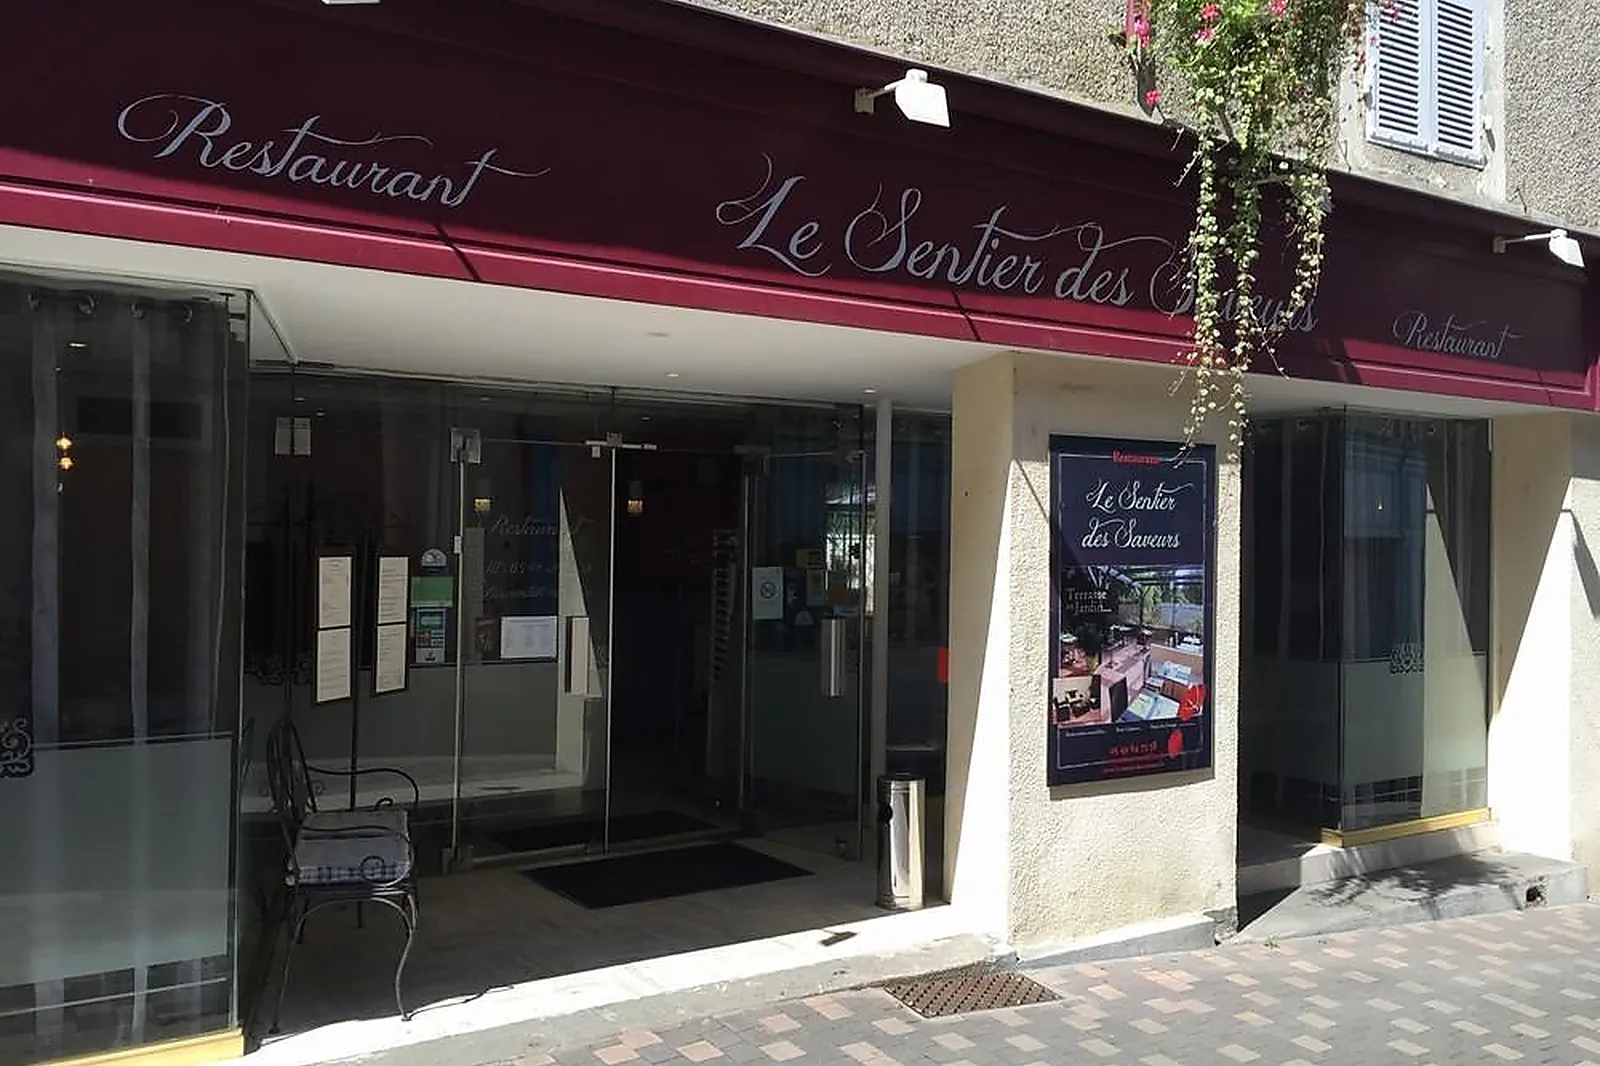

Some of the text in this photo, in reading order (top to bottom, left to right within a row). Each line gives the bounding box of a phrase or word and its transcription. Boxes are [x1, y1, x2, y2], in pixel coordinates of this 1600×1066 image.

[117, 93, 551, 208] Restaurant
[715, 152, 833, 277] Le
[844, 182, 1062, 295] Sentier
[1055, 222, 1172, 307] des
[1392, 309, 1524, 359] Restaurant
[1086, 478, 1195, 514] Le Sentier
[1081, 516, 1181, 549] des Saveurs
